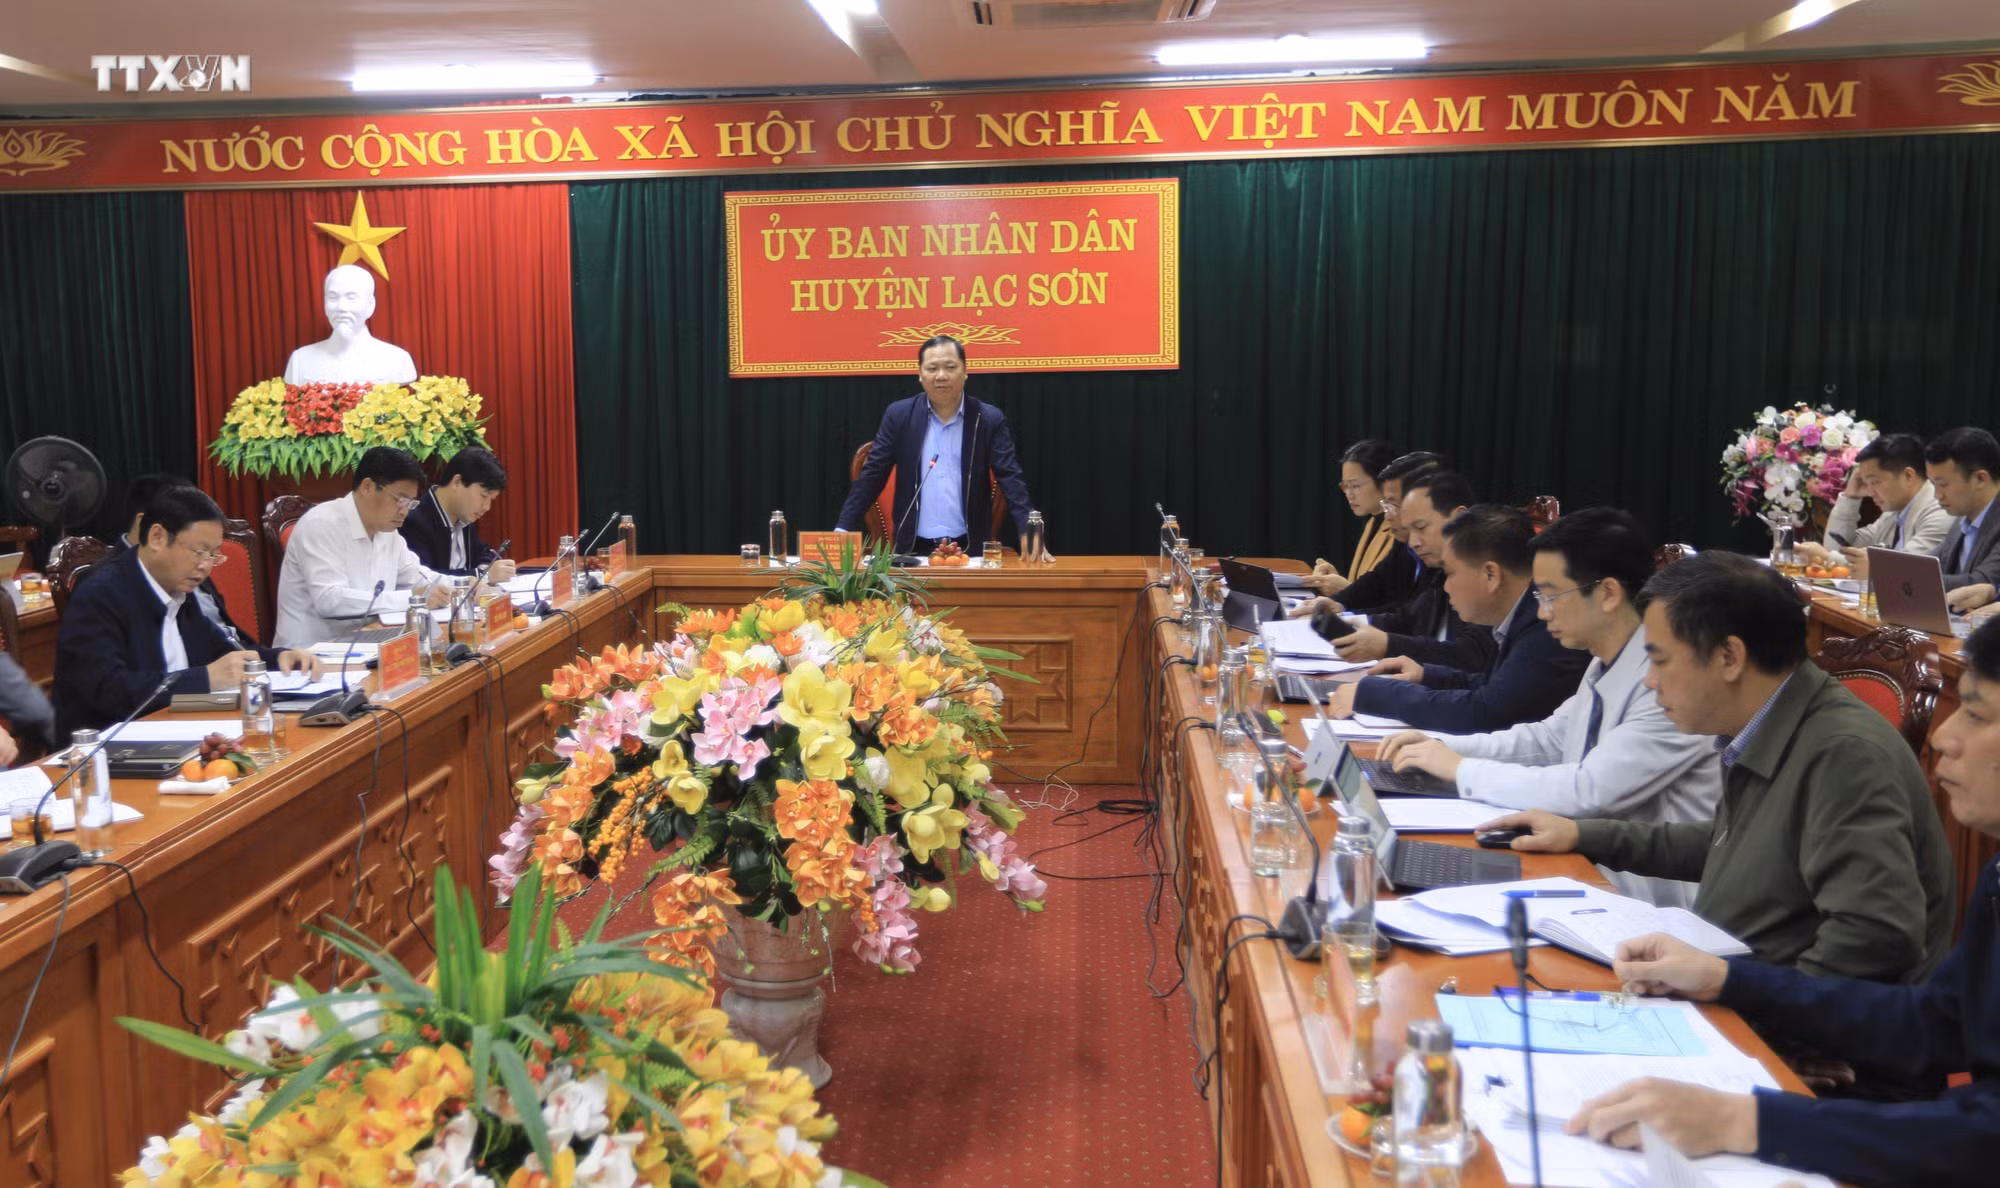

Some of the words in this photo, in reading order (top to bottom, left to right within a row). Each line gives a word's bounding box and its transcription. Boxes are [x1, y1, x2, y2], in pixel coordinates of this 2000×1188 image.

[160, 126, 305, 173] NƯỚC
[319, 123, 469, 175] CỘNG
[481, 115, 599, 165] HÒA
[614, 114, 697, 161] XÃ
[715, 109, 815, 164] HỘI
[837, 101, 953, 153] CHỦ
[975, 101, 1163, 149] NGHĨA
[1183, 91, 1327, 149] VIỆT
[1343, 95, 1487, 137] NAM
[1505, 79, 1693, 131] MUÔN
[1711, 73, 1861, 123] NĂM
[759, 213, 817, 263] ỦY
[827, 223, 911, 261] BAN
[921, 211, 1038, 257] NHÂN
[1050, 207, 1139, 255] DÂN
[789, 267, 931, 319] HUYỆN
[941, 273, 1019, 317] LẠC
[1027, 265, 1109, 309] SƠN
